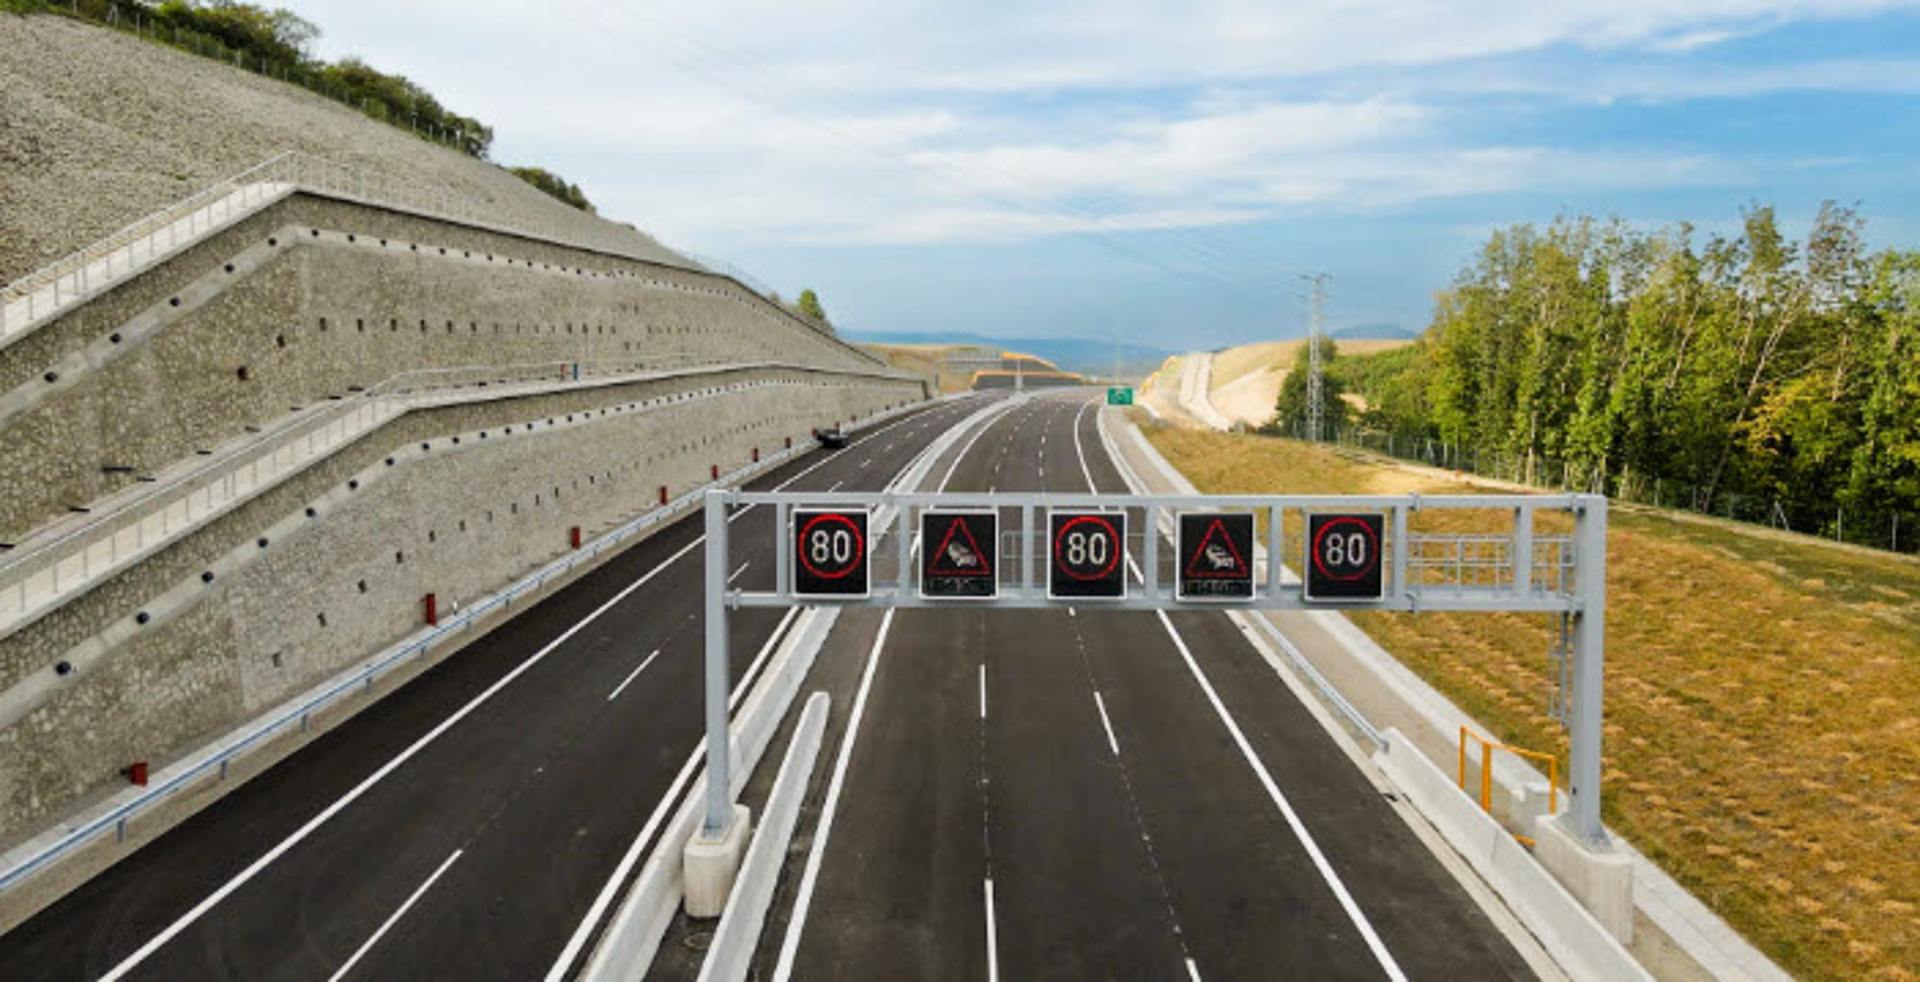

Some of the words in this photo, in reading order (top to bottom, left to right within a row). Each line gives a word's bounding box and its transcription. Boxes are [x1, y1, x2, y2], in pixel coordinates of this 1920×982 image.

[811, 530, 852, 563] 80
[1068, 533, 1107, 564] 80
[1326, 534, 1365, 564] 80
